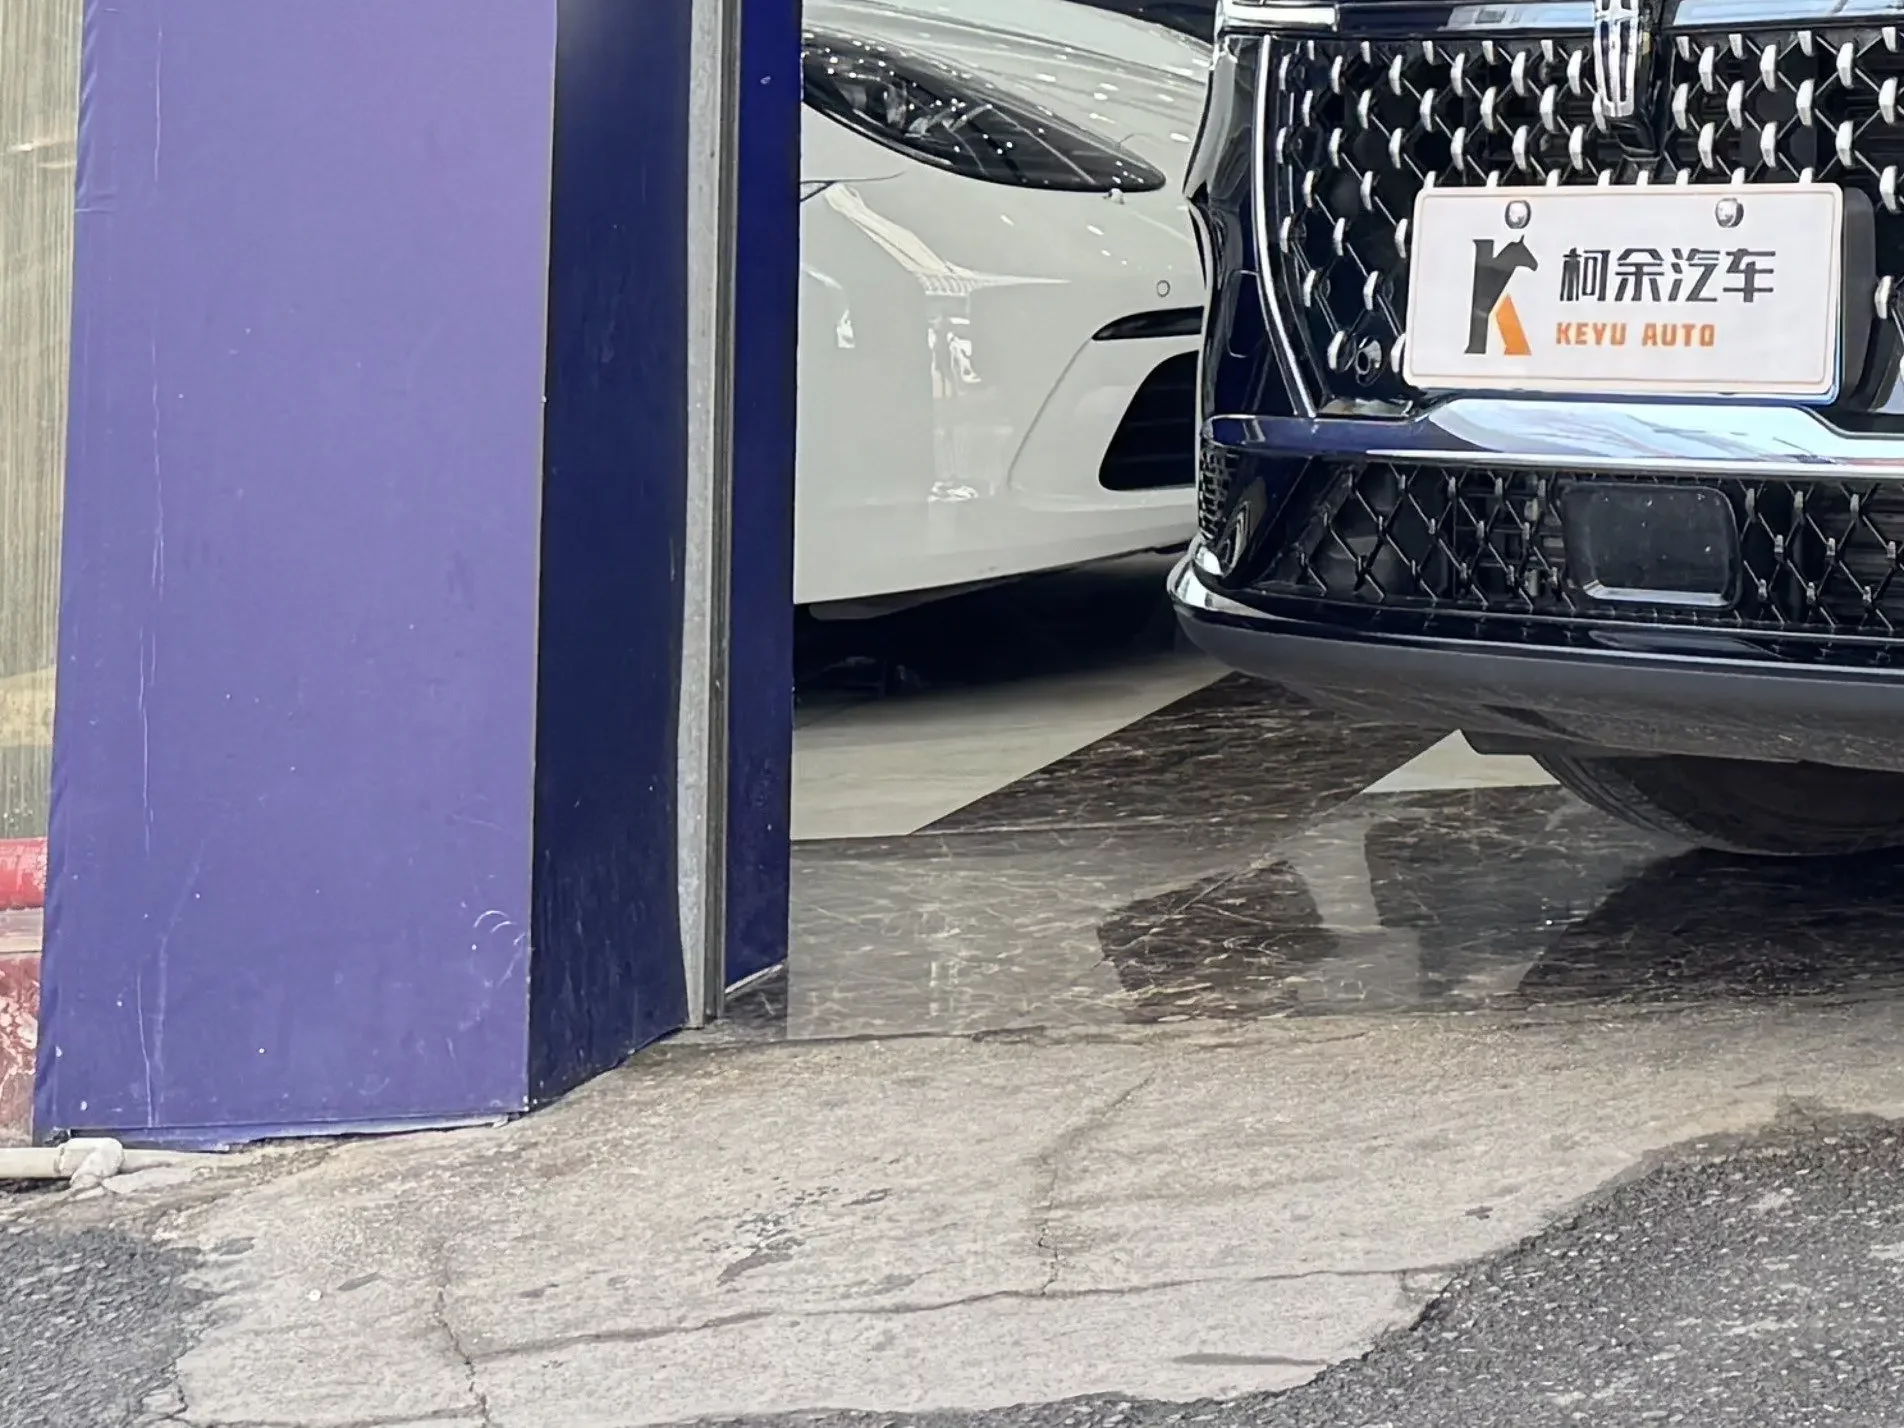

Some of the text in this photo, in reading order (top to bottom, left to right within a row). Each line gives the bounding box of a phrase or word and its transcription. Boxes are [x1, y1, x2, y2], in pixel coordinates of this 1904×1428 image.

[1559, 246, 1777, 304] 柯余汽车
[1555, 321, 1716, 348] KEYU AUTO
